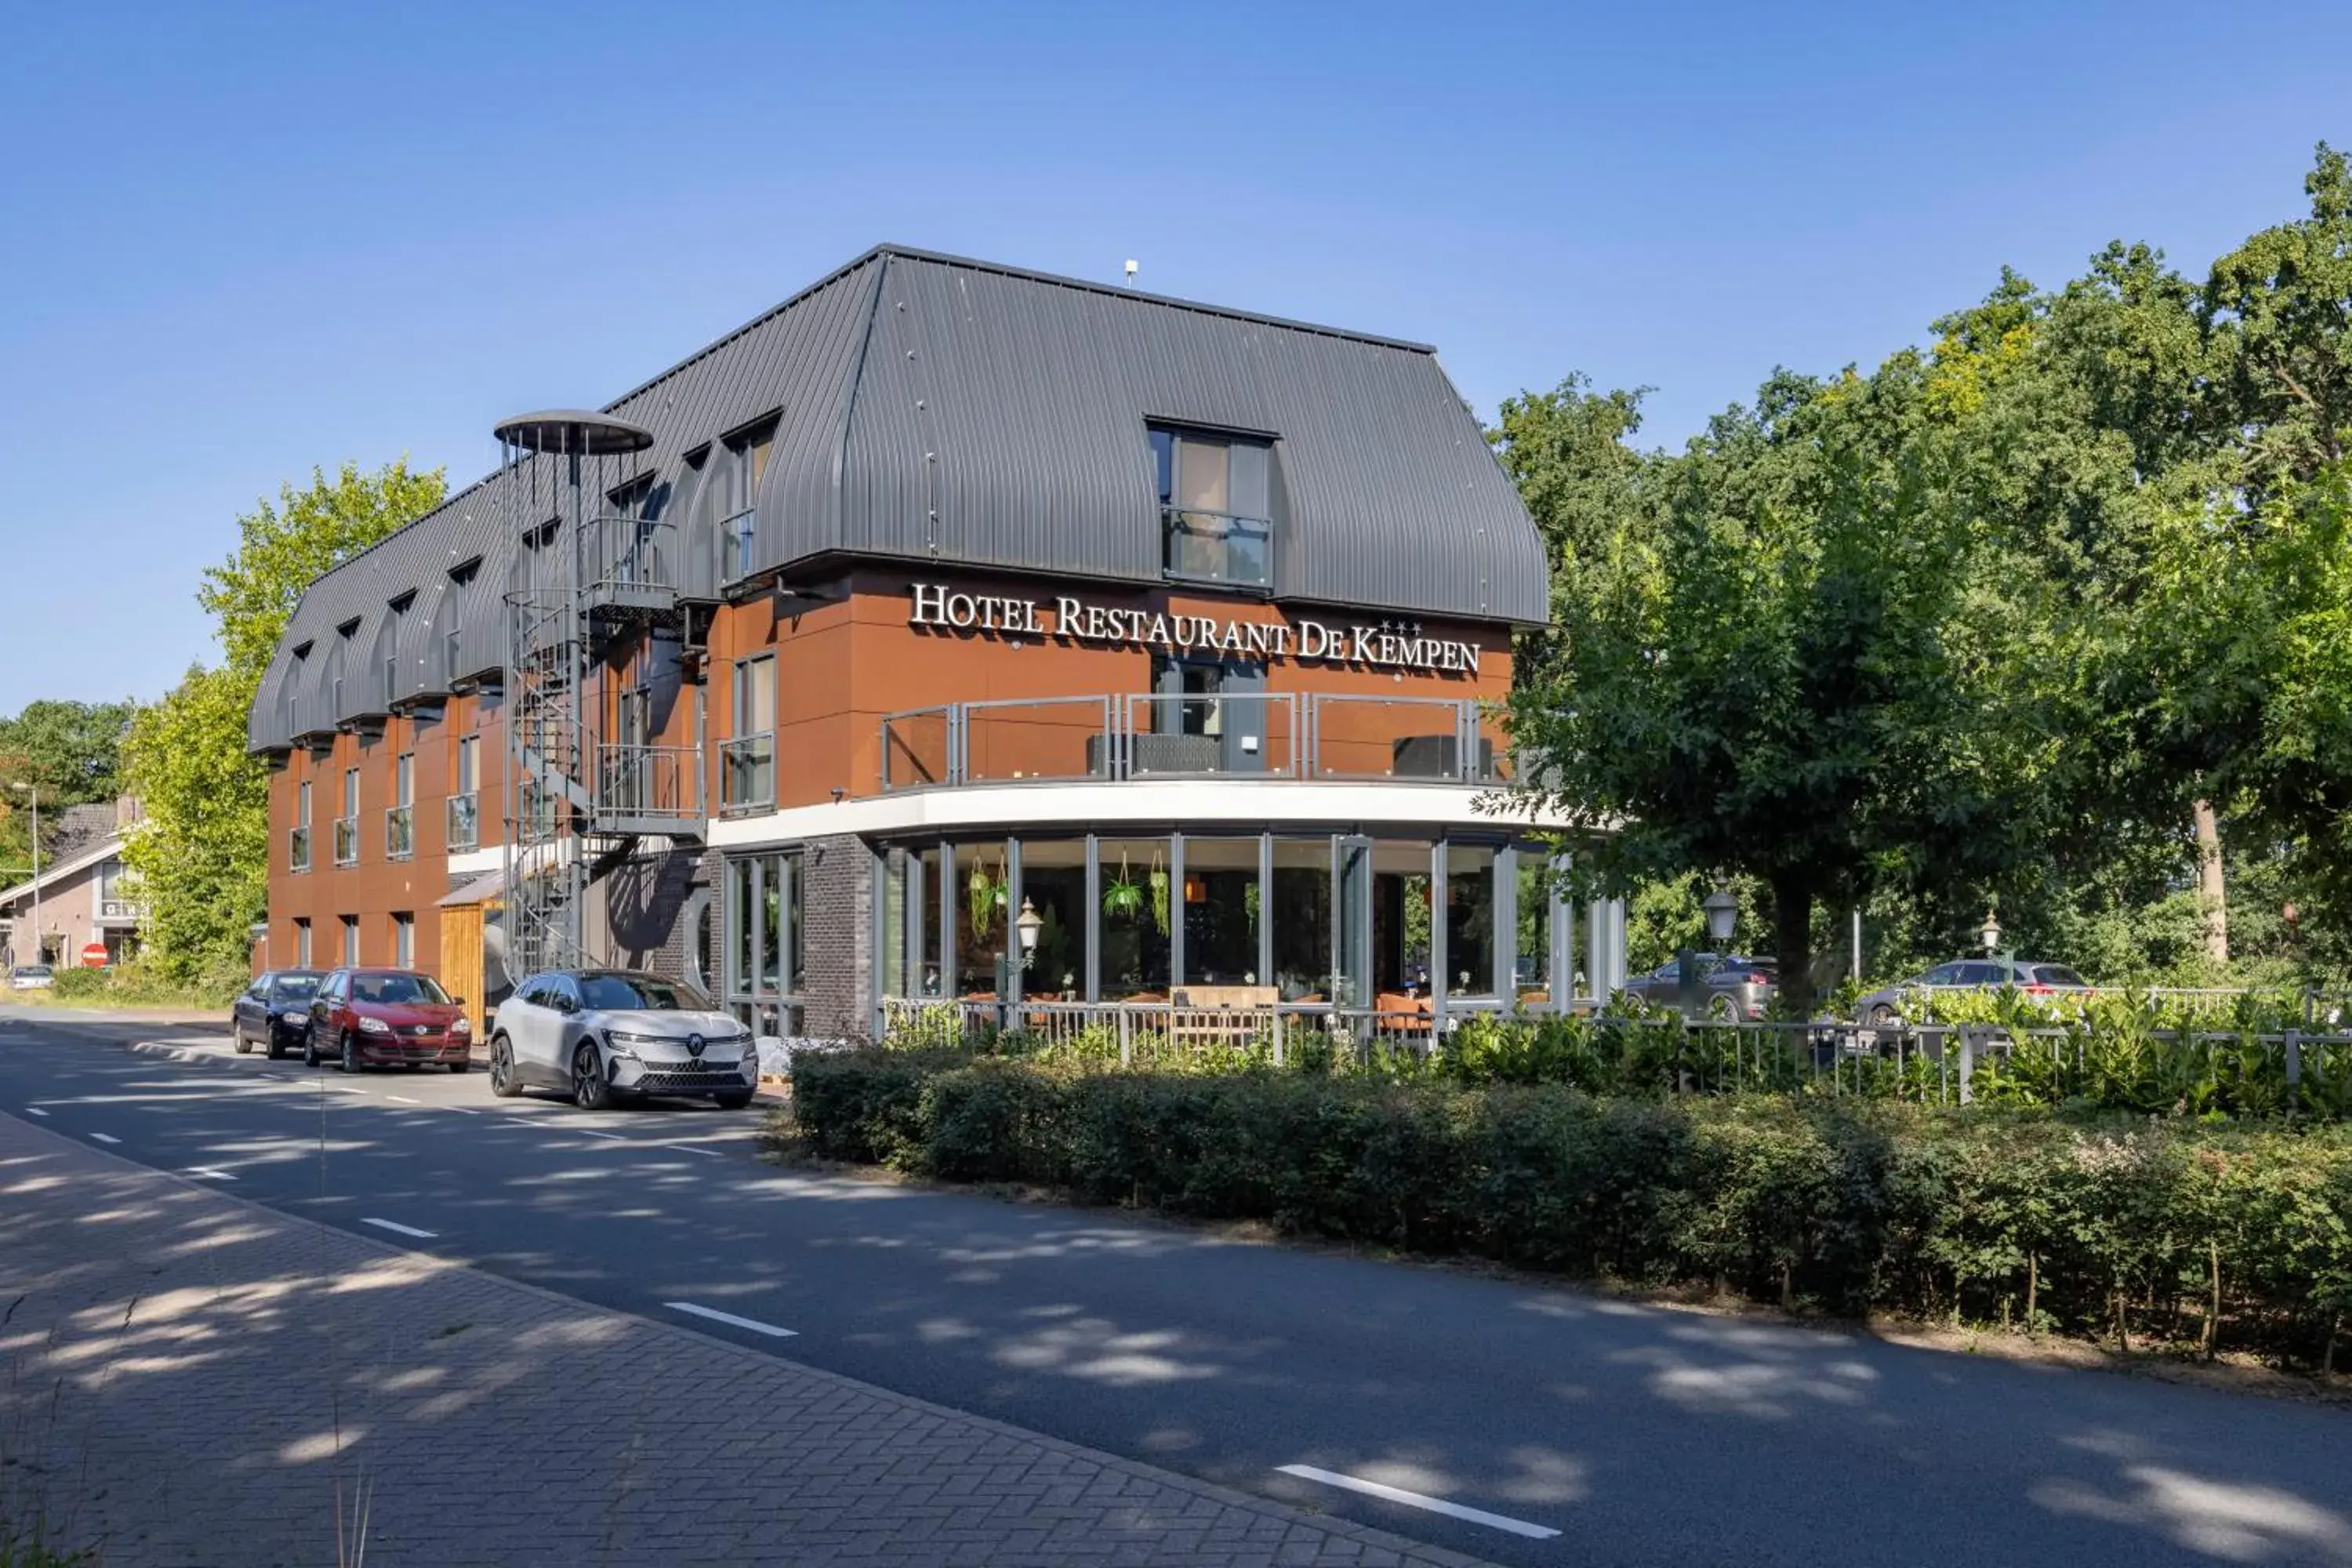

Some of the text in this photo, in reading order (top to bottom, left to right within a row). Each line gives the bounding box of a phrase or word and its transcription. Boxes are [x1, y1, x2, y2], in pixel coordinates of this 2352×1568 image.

[910, 583, 1481, 672] HOTEL RESTAURANT DE KEMPEN
